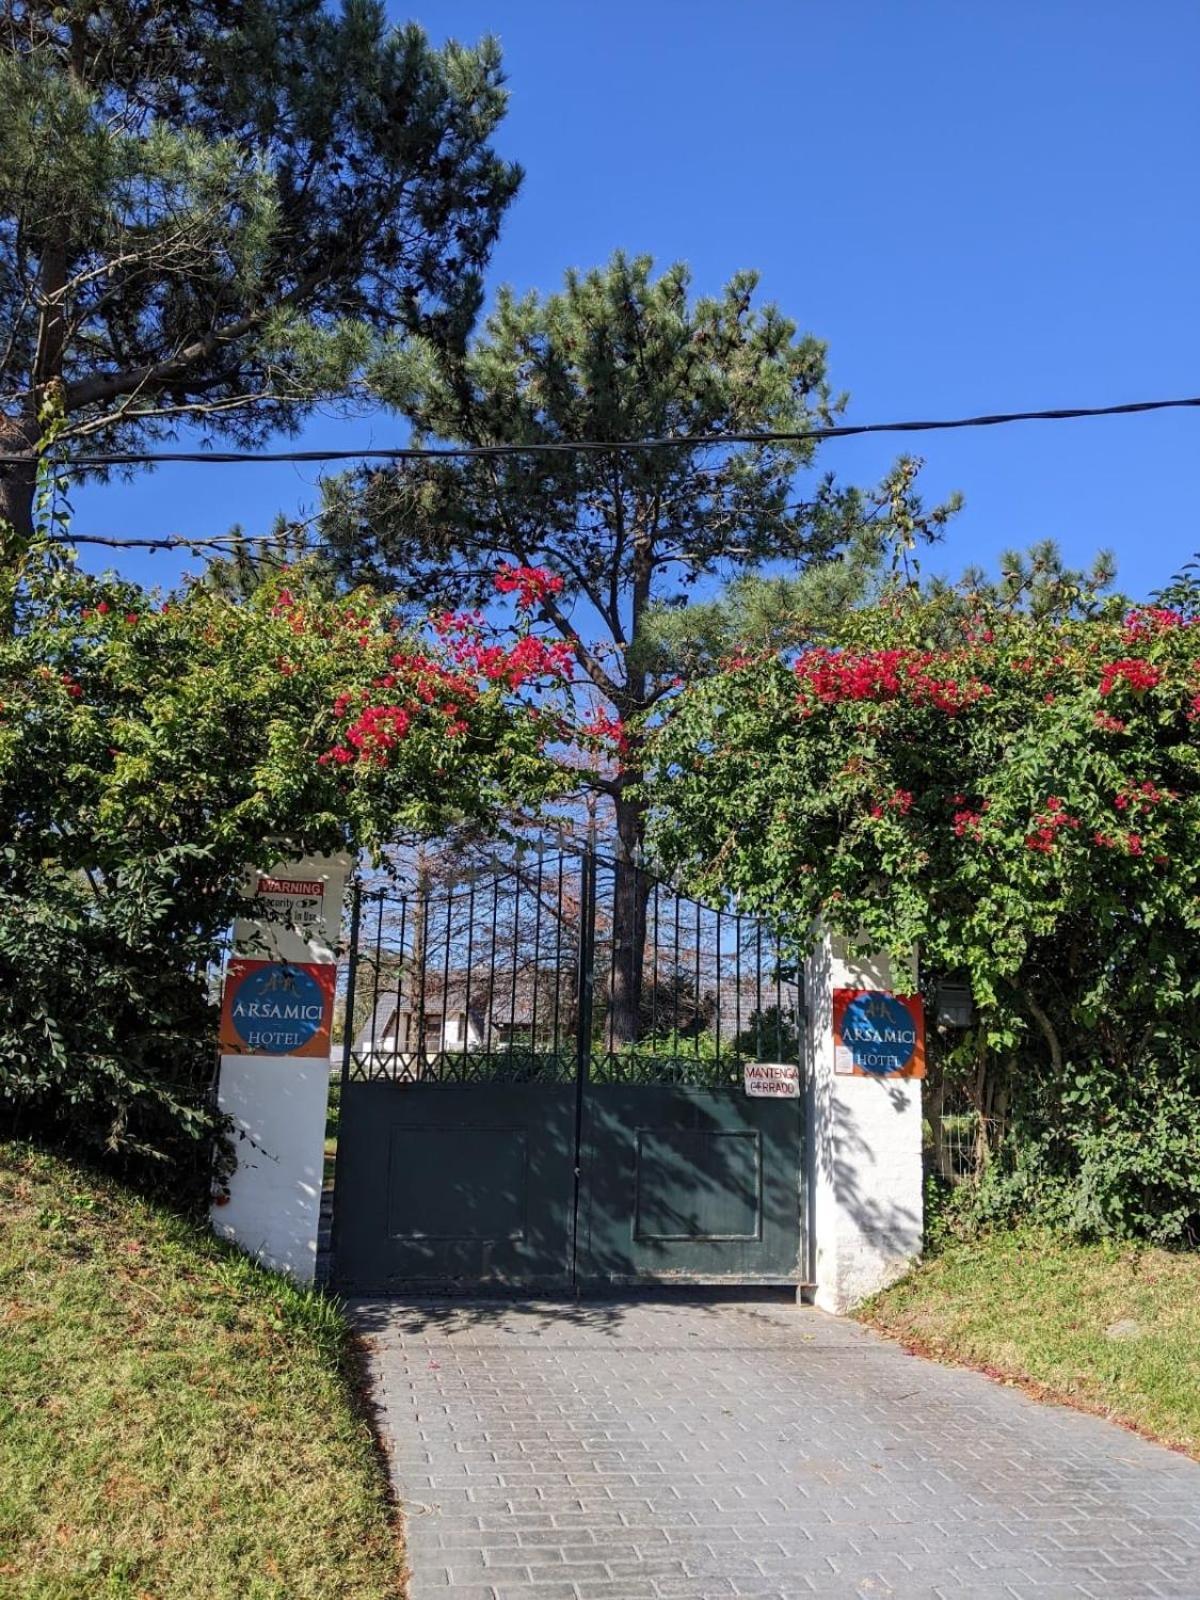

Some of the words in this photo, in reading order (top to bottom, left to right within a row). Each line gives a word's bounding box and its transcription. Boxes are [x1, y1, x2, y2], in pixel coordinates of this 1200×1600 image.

[262, 881, 321, 894] WARNING
[262, 897, 294, 909] ecurity
[232, 1002, 324, 1020] ARSAMICI
[247, 1031, 303, 1045] HOTEL
[843, 1027, 916, 1044] ARSAMICI
[857, 1053, 902, 1067] HOTEL
[746, 1066, 799, 1079] MANTENGA
[750, 1081, 795, 1094] CERRADO
